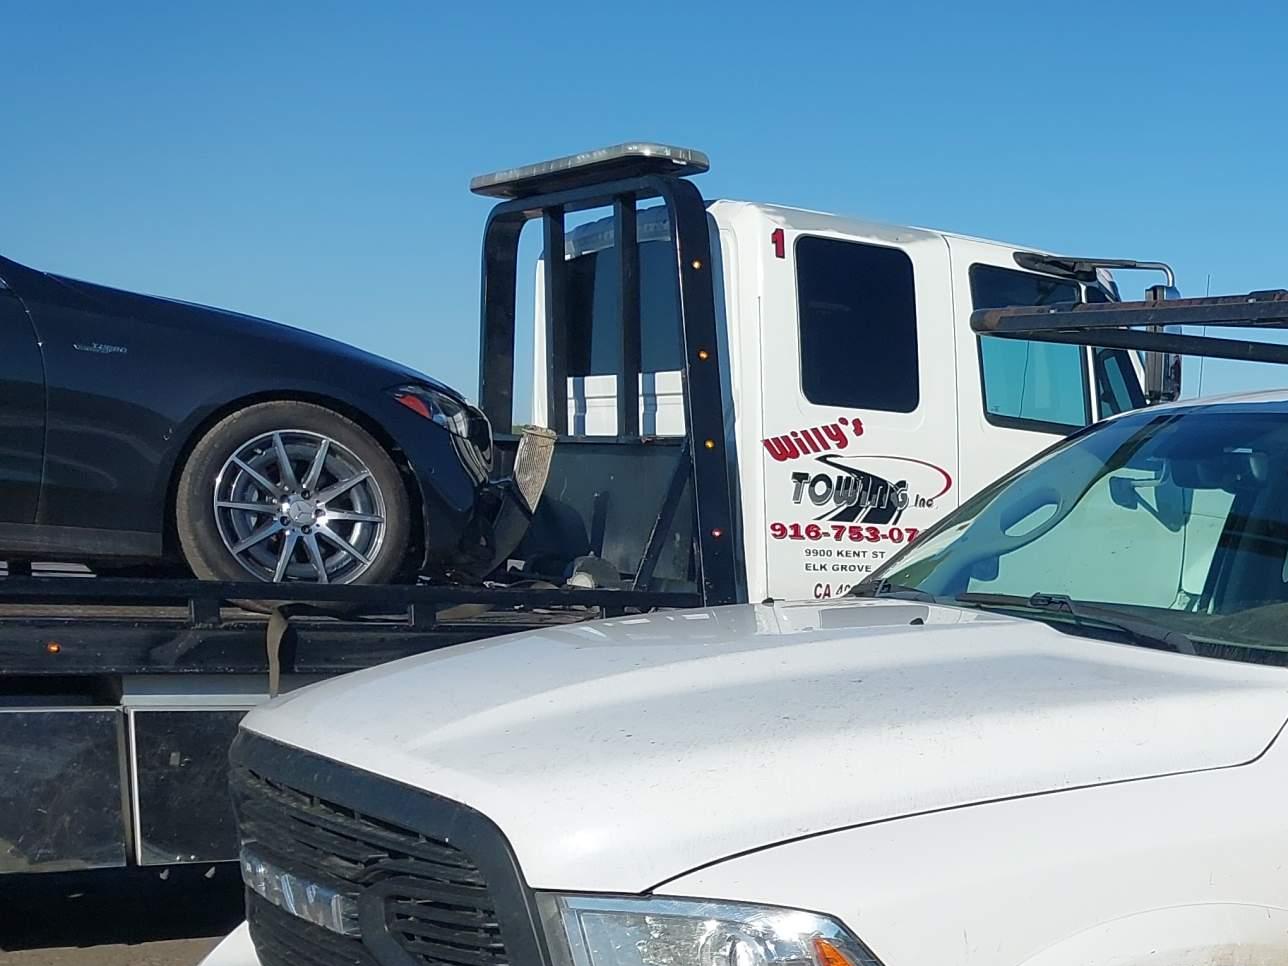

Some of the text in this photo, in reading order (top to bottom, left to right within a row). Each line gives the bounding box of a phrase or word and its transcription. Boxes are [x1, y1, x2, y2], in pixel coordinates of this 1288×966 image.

[771, 228, 785, 259] 1
[761, 417, 864, 462] Willy's
[804, 548, 886, 559] 9900 KENT ST
[805, 563, 872, 573] ELK GROVE
[814, 583, 831, 599] CA
